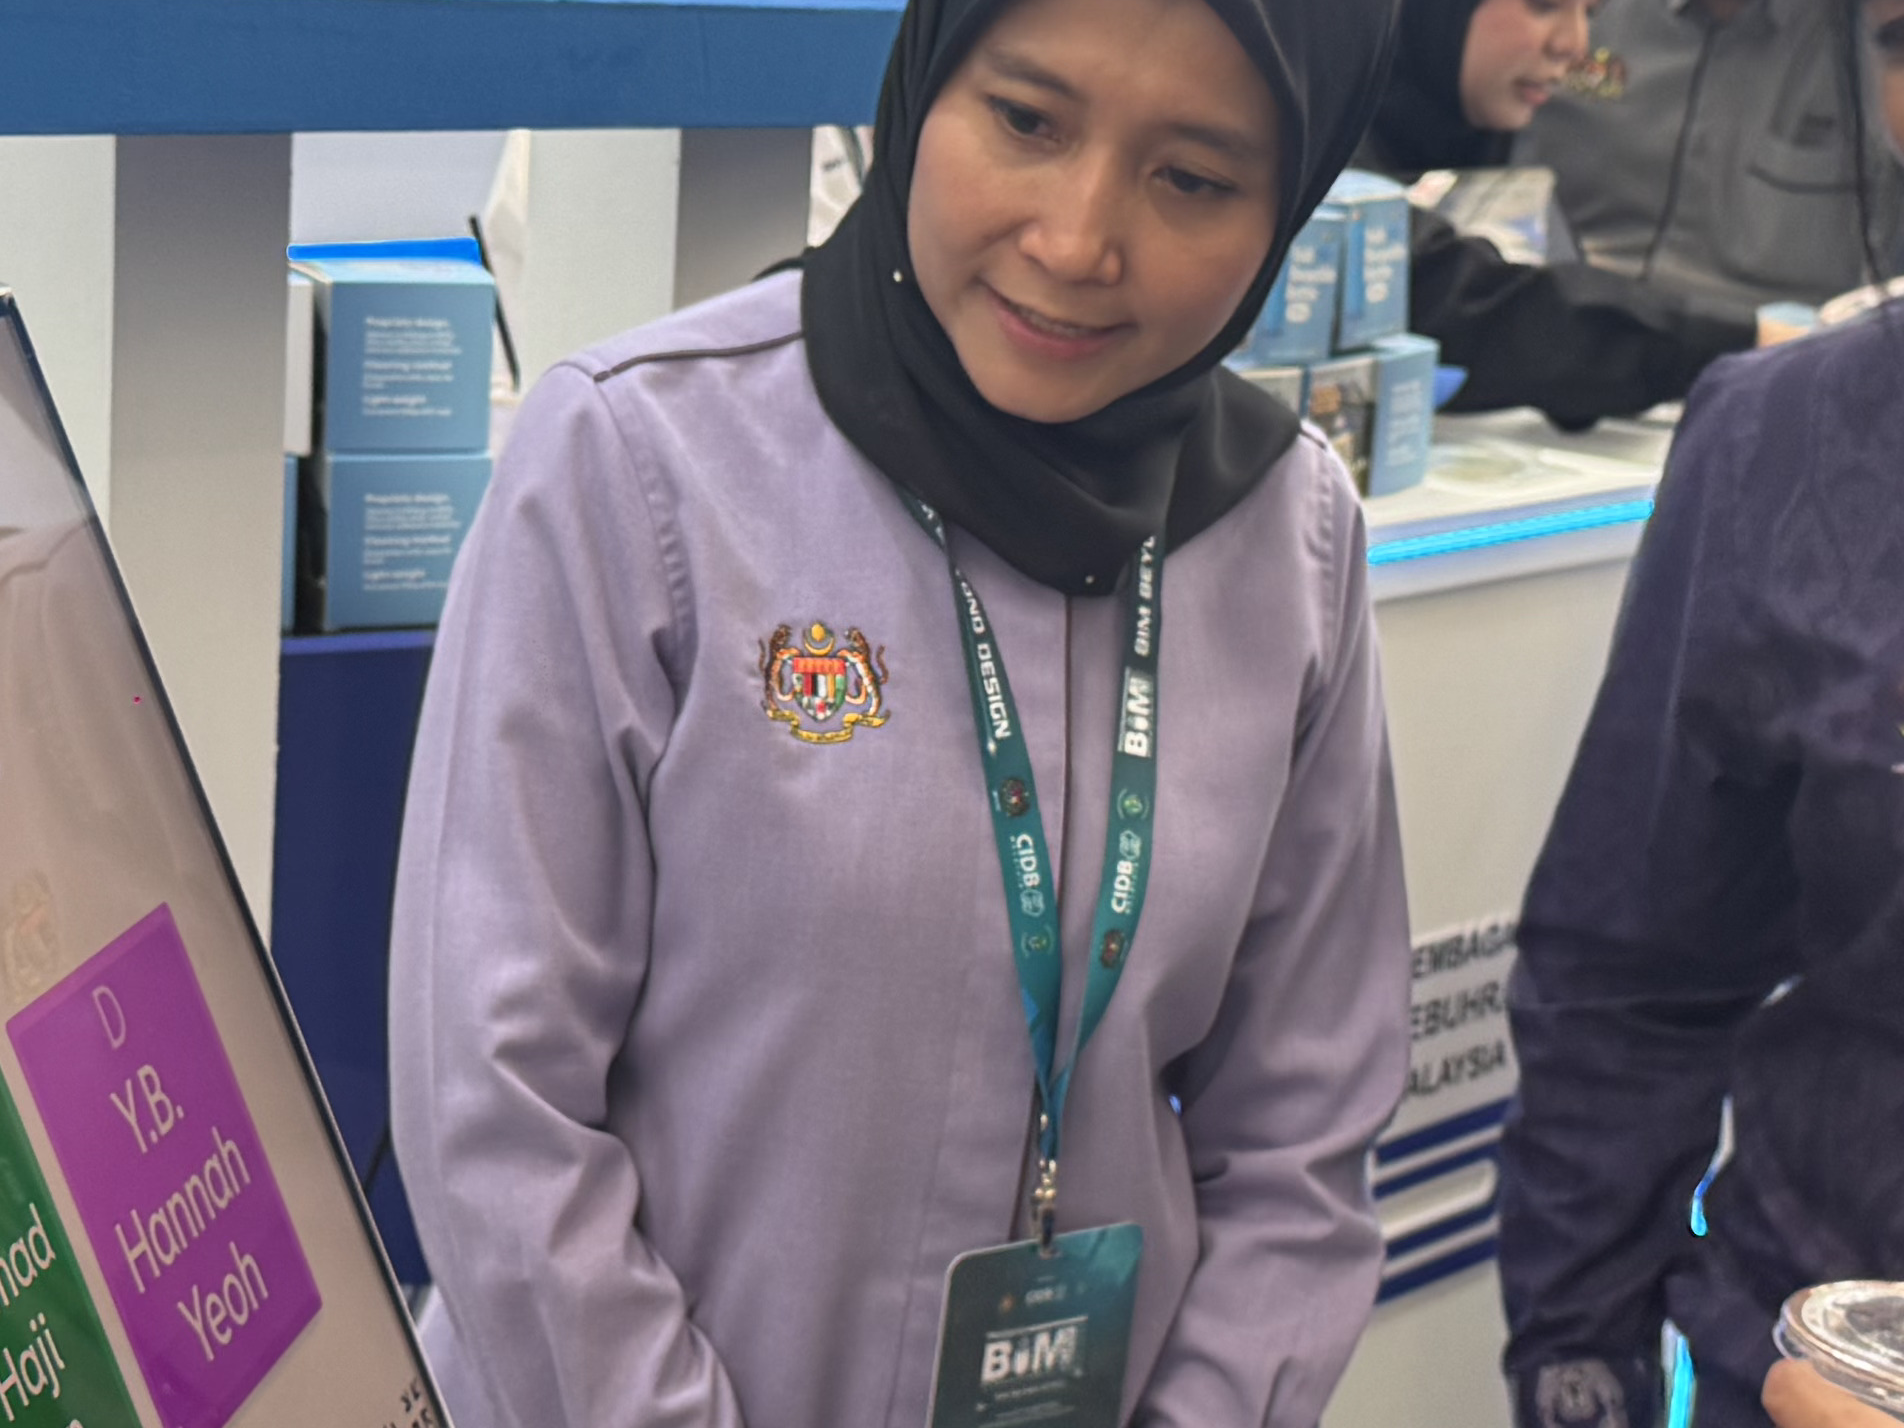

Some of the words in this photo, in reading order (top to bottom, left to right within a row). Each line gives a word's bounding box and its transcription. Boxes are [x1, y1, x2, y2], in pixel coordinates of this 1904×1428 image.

[1134, 612, 1152, 656] BIM
[977, 643, 1011, 739] DESIGN
[1016, 833, 1041, 888] CIDB
[1111, 860, 1133, 913] CIDB
[92, 983, 128, 1052] D
[110, 1062, 185, 1156] Y.B.
[114, 1133, 252, 1295] Hannah
[178, 1249, 269, 1363] Yeoh
